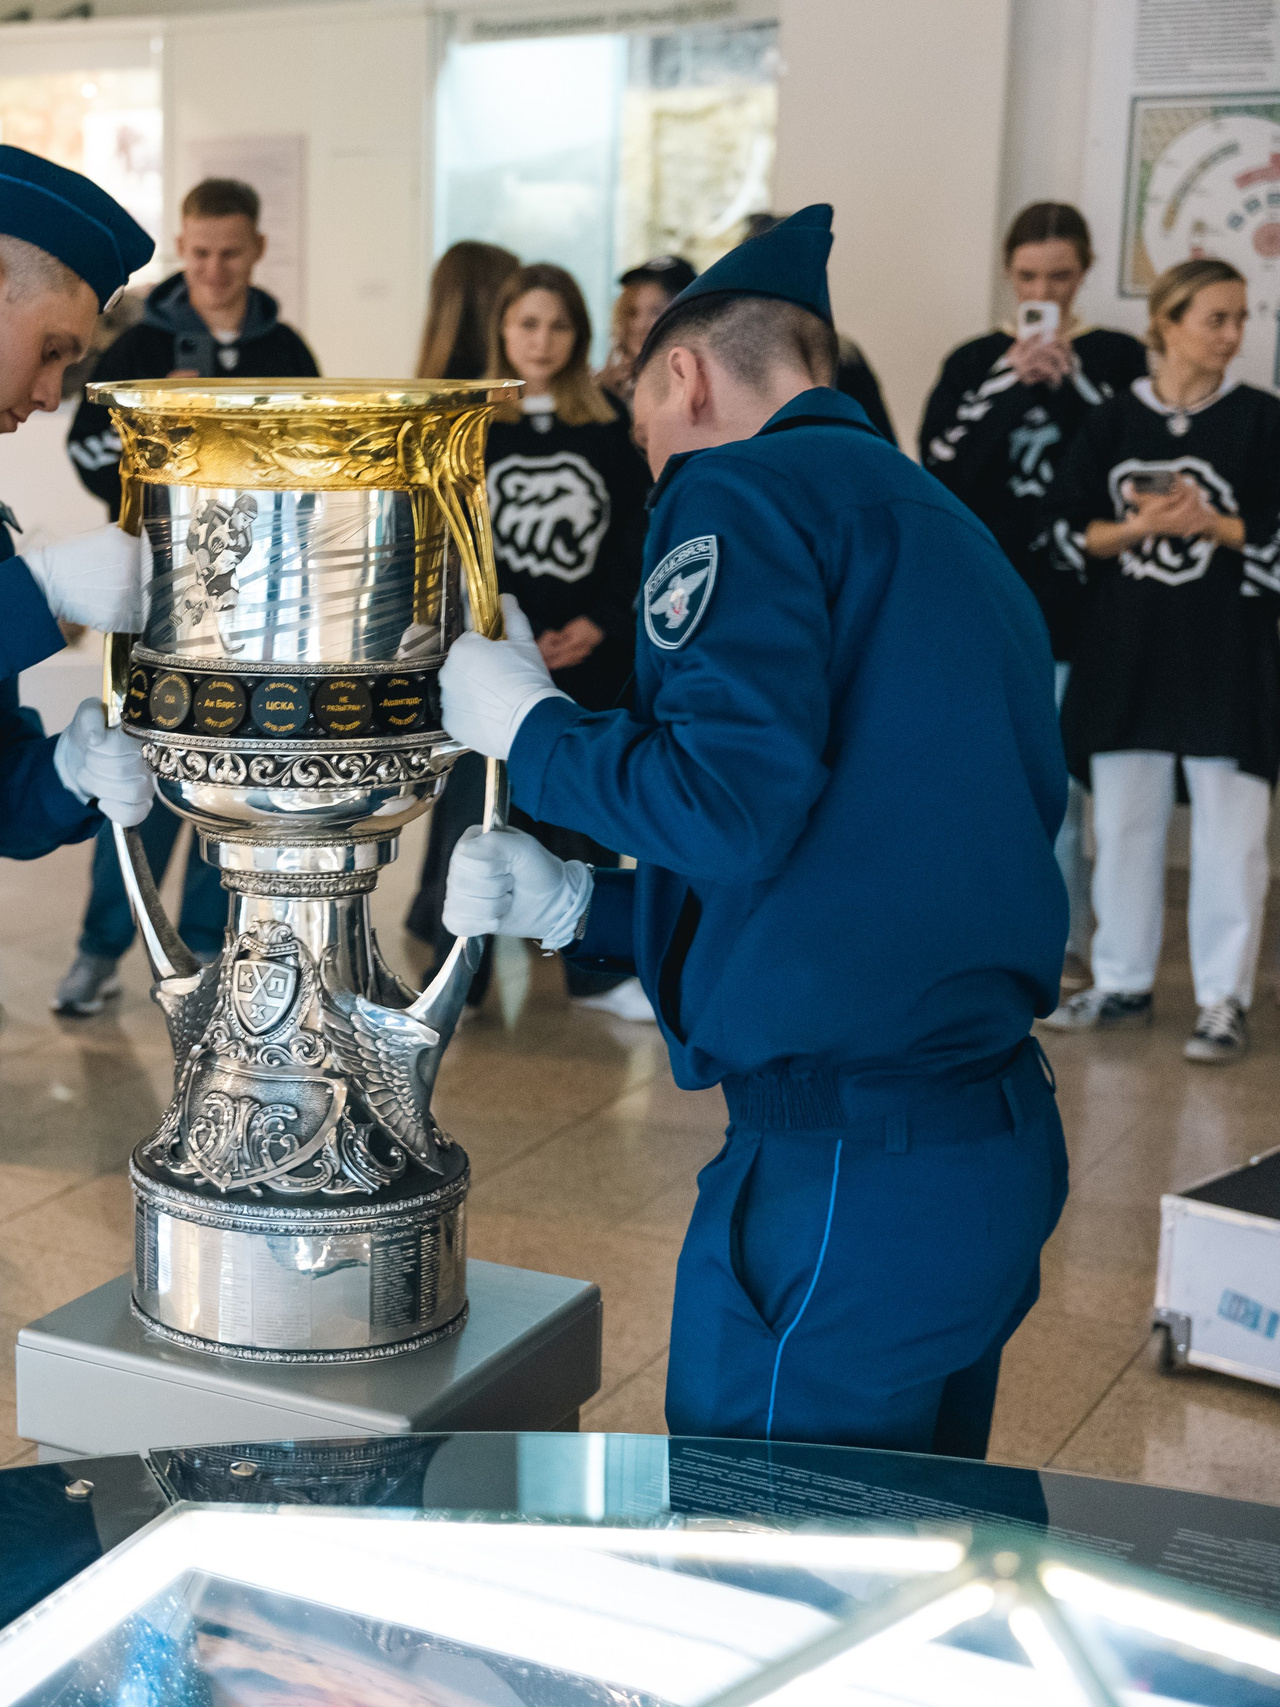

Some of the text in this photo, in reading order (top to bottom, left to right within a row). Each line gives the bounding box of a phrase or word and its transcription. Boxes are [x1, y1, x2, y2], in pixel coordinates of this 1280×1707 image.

[265, 701, 296, 712] ЦСКА
[239, 971, 286, 993] К Л
